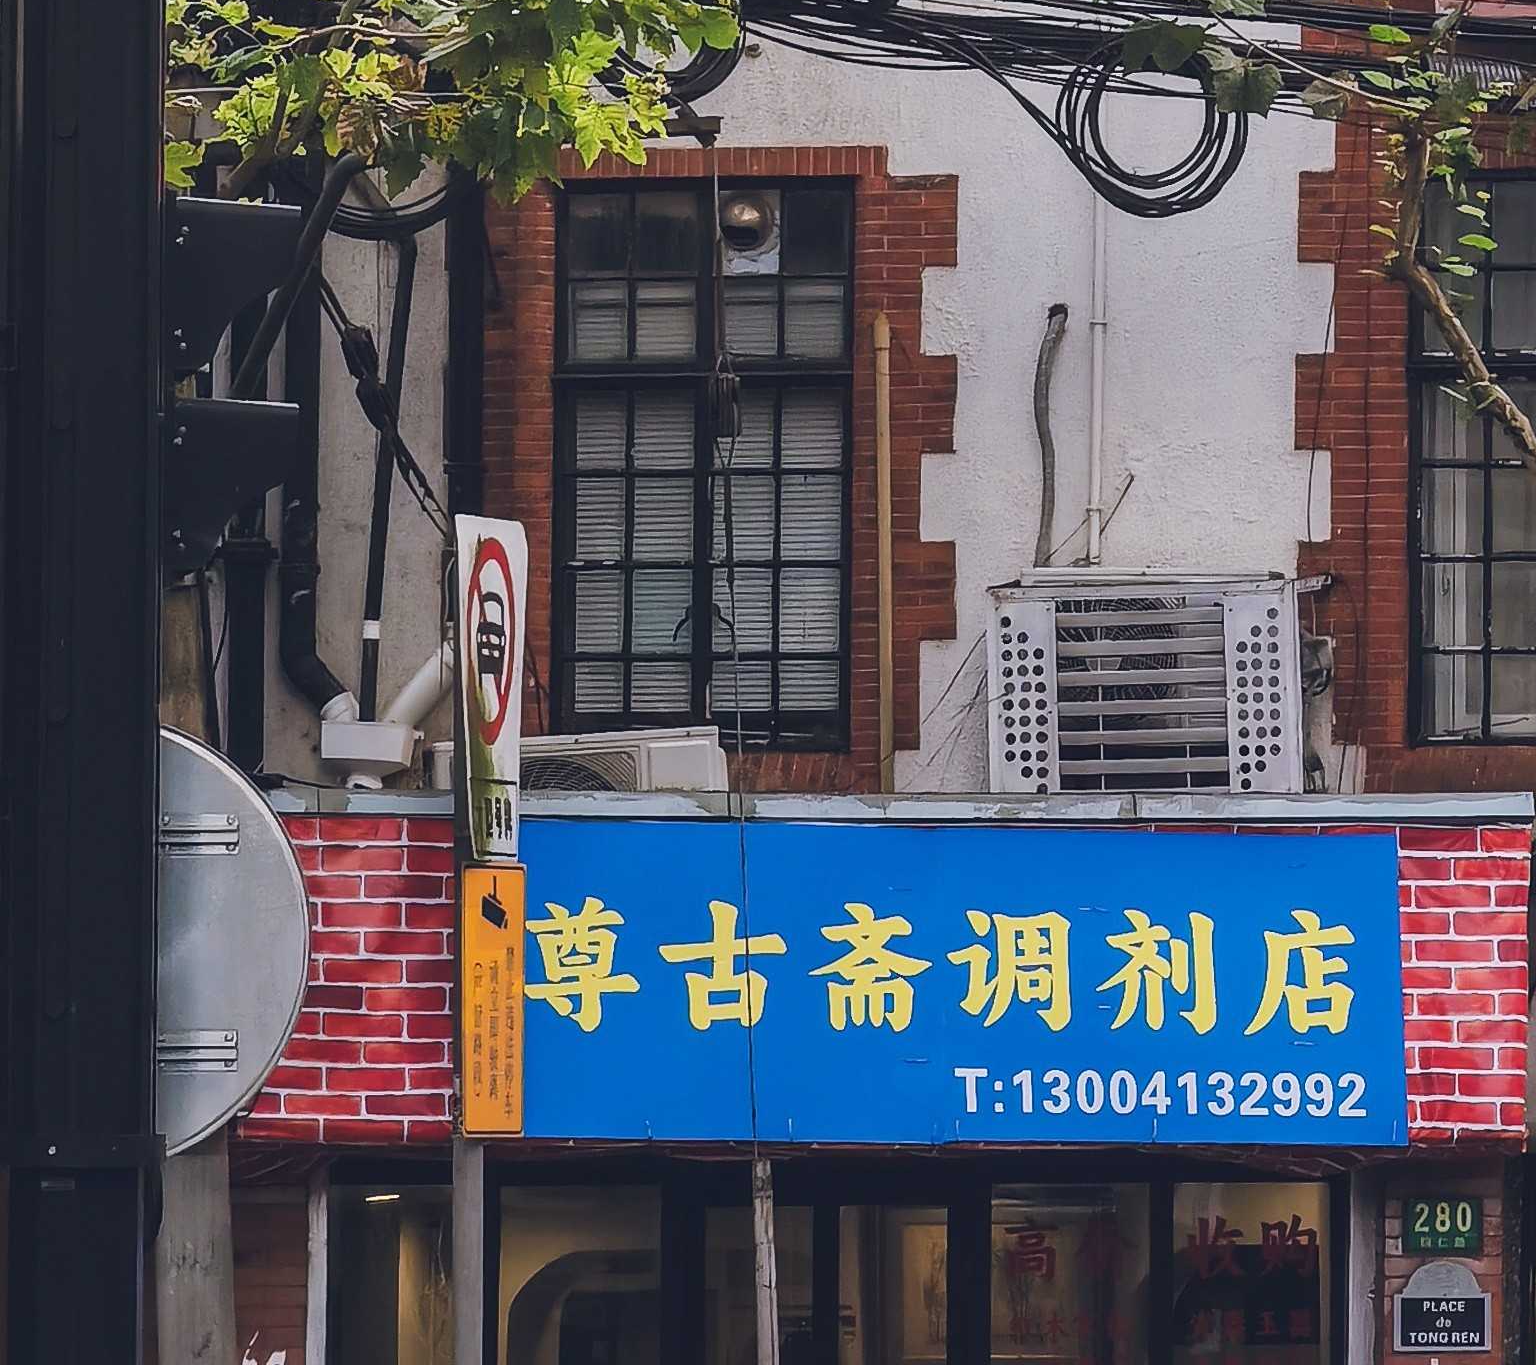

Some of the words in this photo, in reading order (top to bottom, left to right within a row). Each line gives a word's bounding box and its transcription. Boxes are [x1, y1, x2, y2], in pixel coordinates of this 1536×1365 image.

[525, 897, 1357, 1035] 尊古斋调剂店
[954, 1067, 1367, 1117] T:13004132992
[1414, 1201, 1472, 1233] 280
[1423, 1300, 1466, 1312] PLACE
[1409, 1331, 1448, 1344] TONG
[1451, 1331, 1480, 1344] REN
